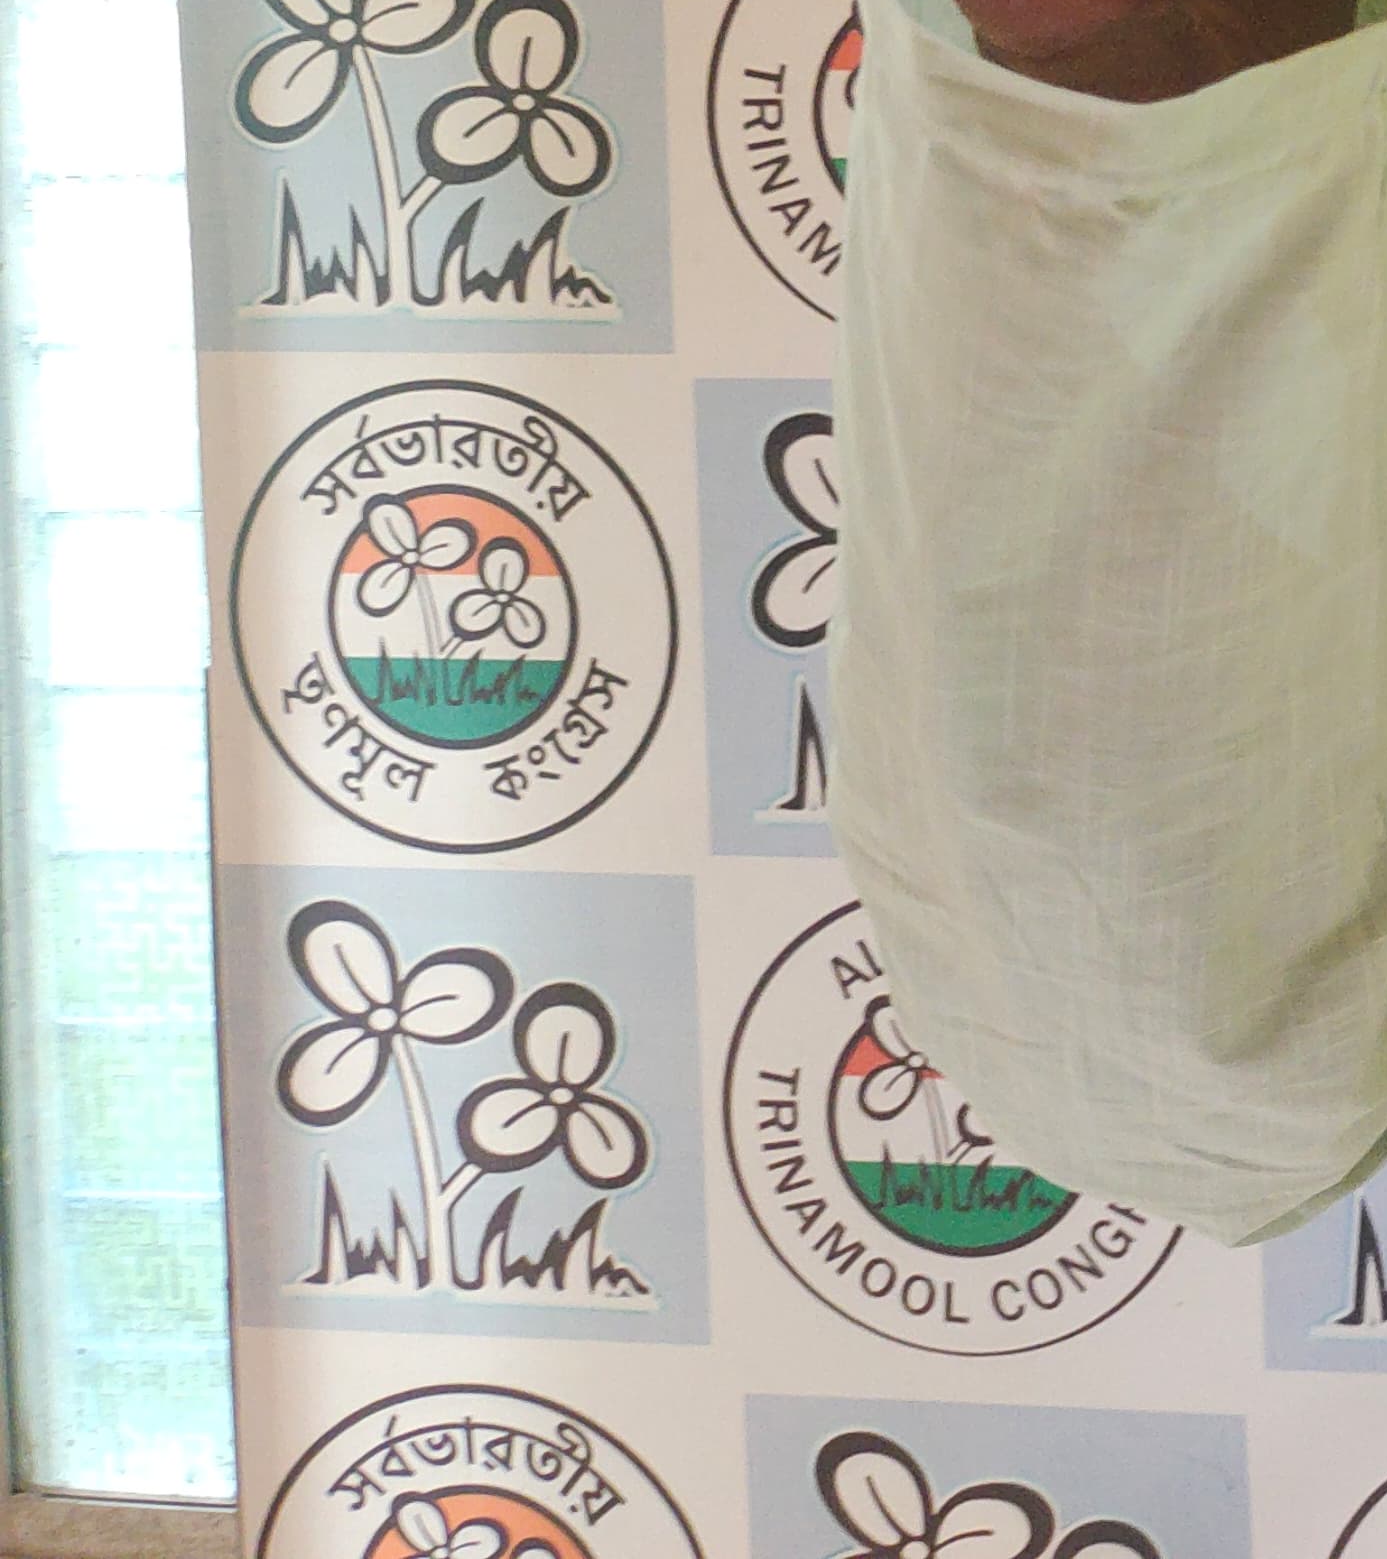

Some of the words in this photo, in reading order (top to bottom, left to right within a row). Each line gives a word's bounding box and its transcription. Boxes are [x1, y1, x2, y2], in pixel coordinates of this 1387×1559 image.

[742, 63, 841, 276] TRINAM
[301, 413, 593, 523] সর্বভারতীয়
[281, 651, 438, 802] তৃণমূল
[484, 657, 630, 802] কংগ্রেস
[757, 1068, 970, 1324] TRINAMOOL
[991, 1203, 1147, 1323] CONG
[328, 1415, 627, 1527] সর্বভারতীয়
